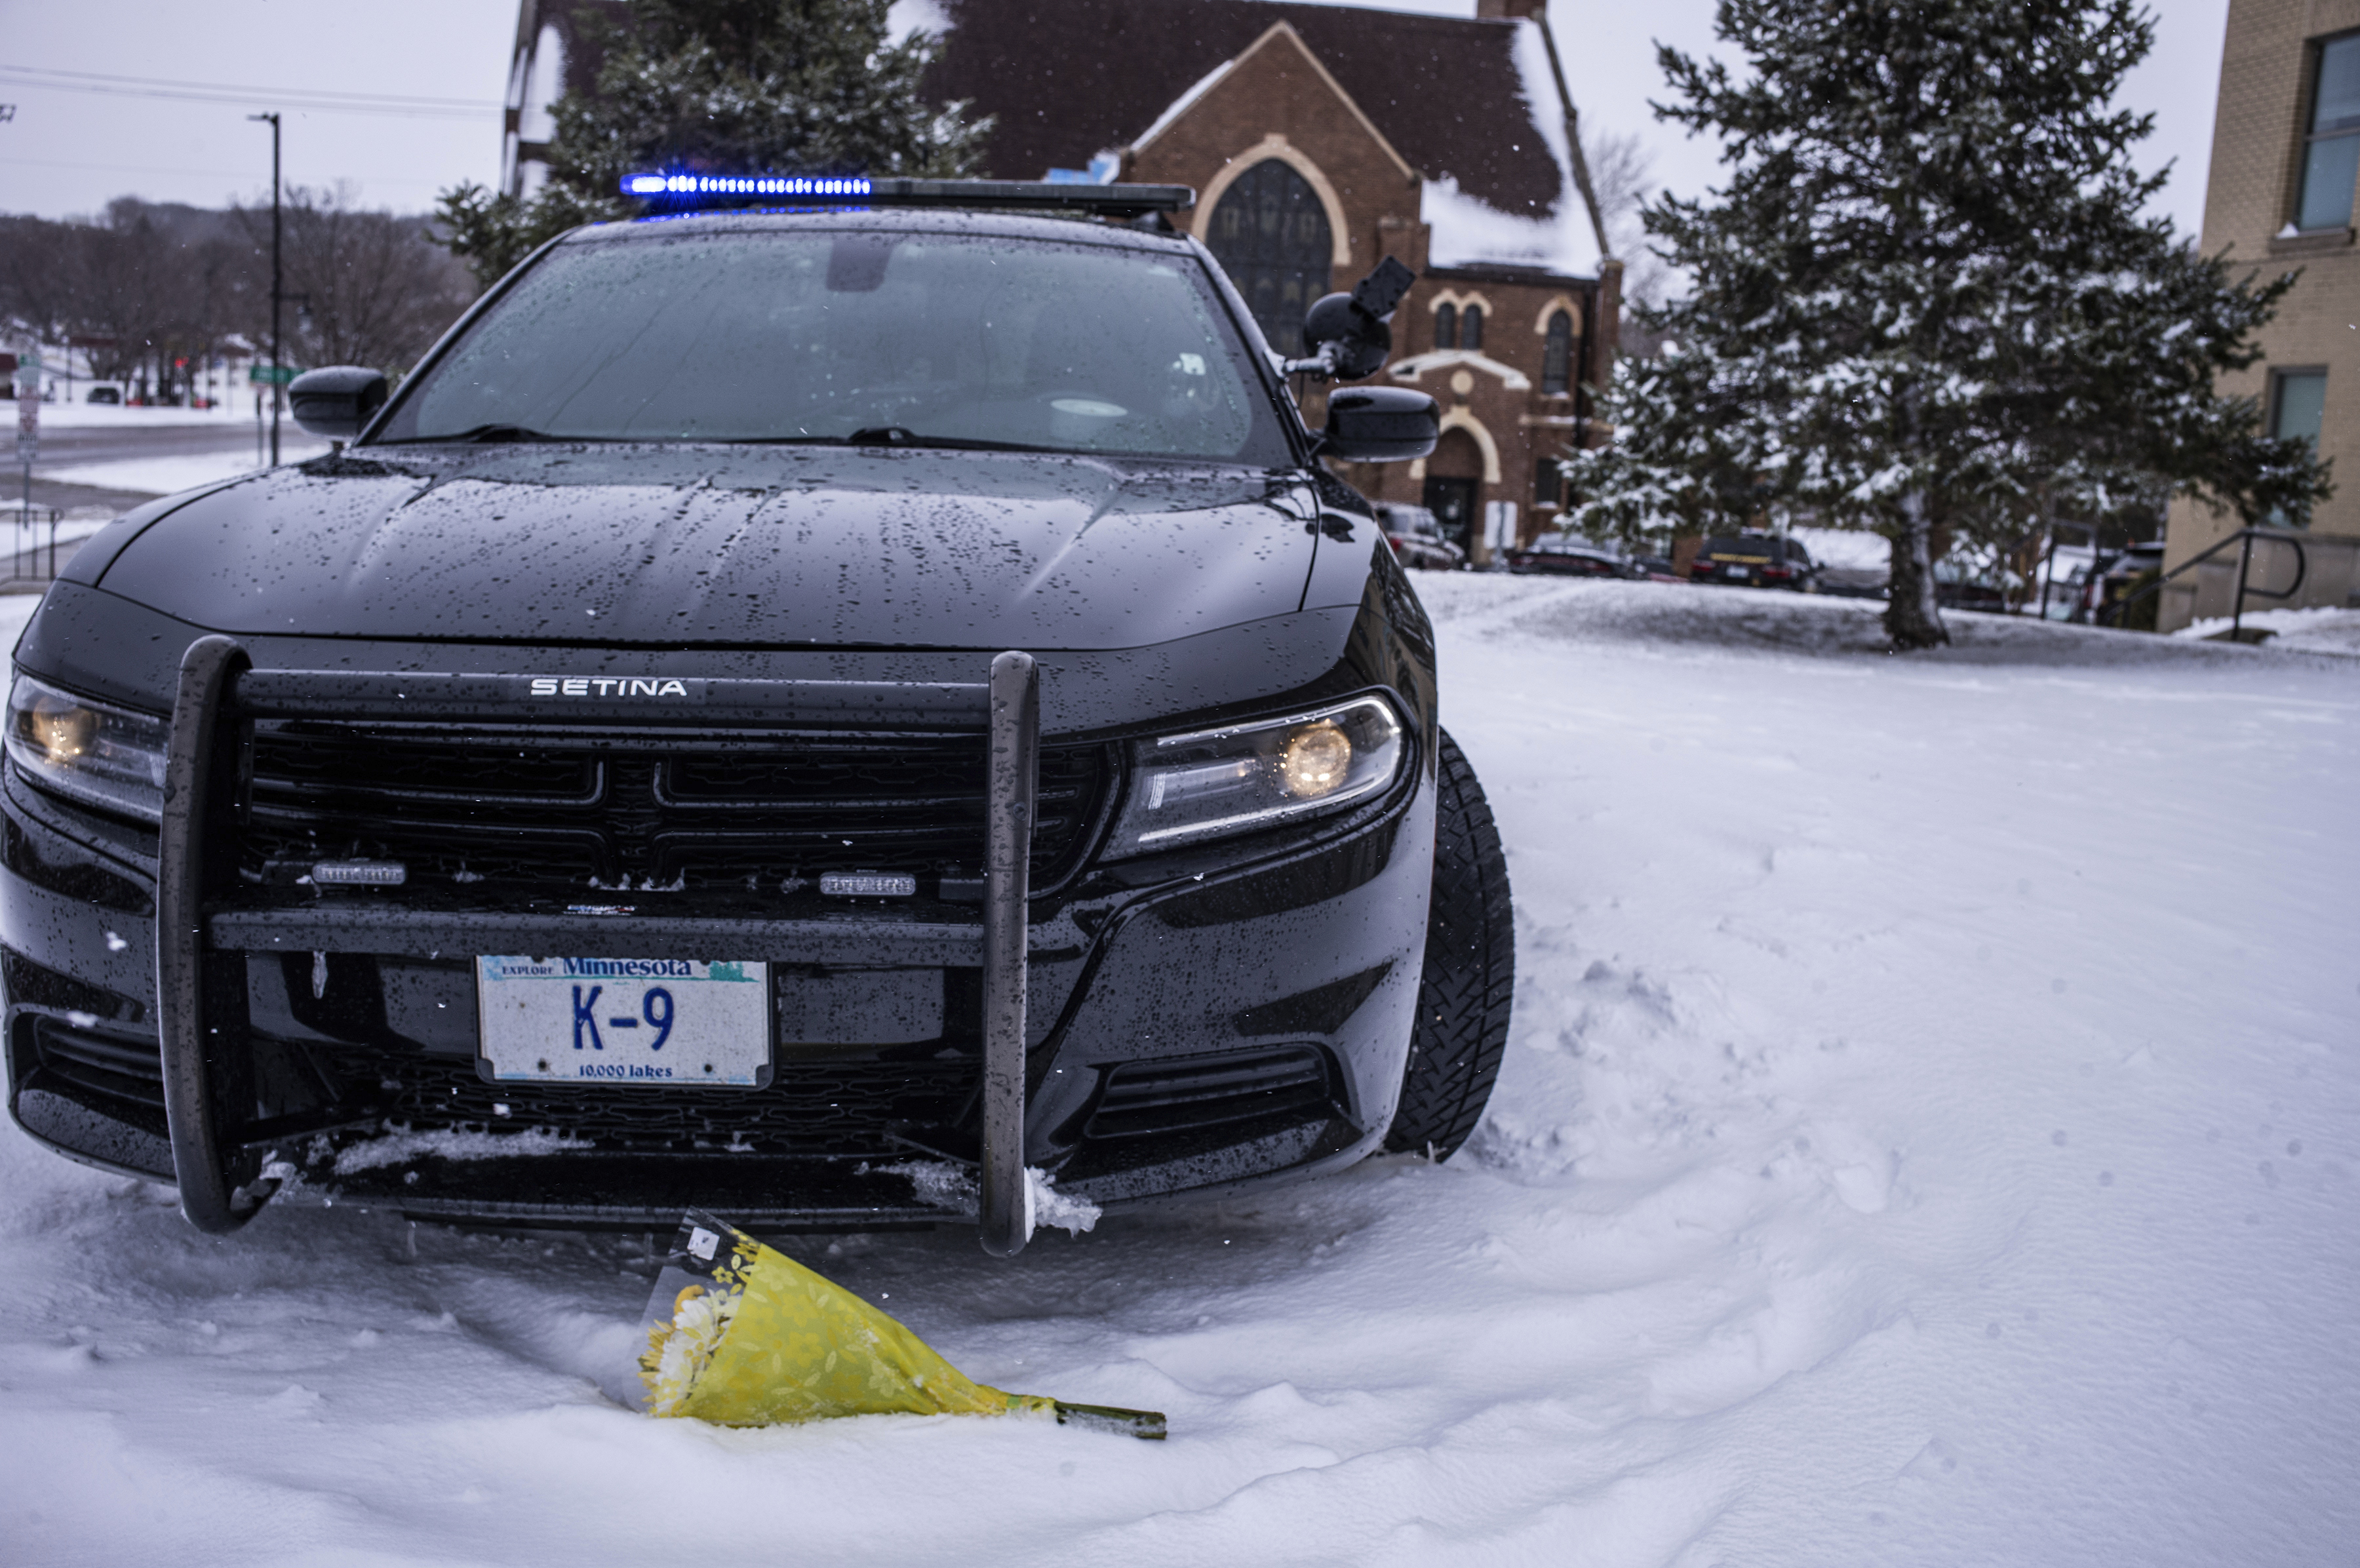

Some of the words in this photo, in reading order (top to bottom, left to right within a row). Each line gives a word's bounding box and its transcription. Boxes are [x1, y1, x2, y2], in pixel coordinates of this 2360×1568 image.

[530, 678, 687, 696] SETINA
[502, 965, 555, 975] EXPLORE
[562, 957, 692, 976] Minnesota
[572, 985, 674, 1050] K-9
[580, 1064, 625, 1078] 10,000
[629, 1064, 673, 1077] lakes
